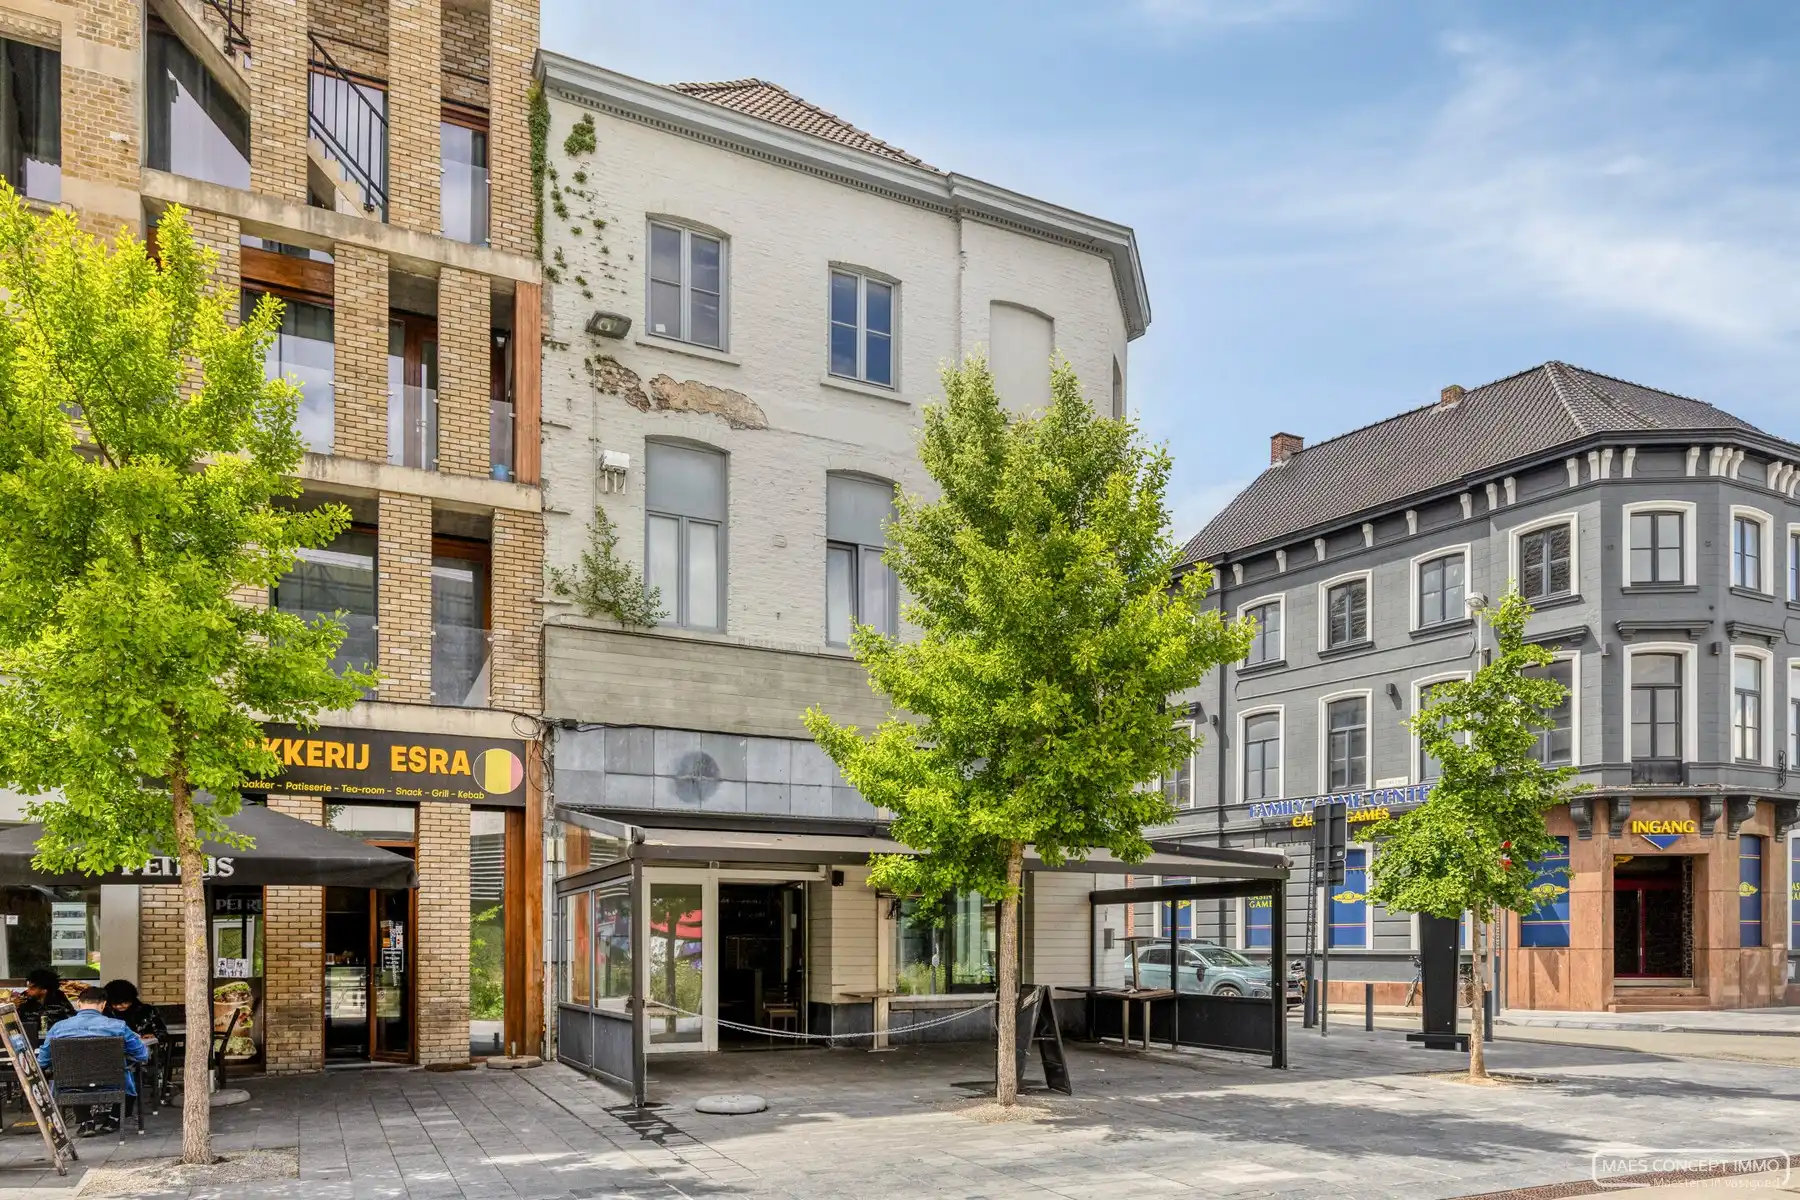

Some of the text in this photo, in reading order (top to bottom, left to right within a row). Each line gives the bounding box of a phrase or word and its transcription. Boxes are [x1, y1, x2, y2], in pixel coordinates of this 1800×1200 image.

[231, 737, 471, 776] KKERIJ ESRA
[286, 781, 332, 792] Patisserie
[341, 784, 385, 795] Tea-room
[395, 787, 423, 797] Snack
[431, 789, 449, 798] Grill
[457, 790, 485, 800] Kebab
[1249, 798, 1307, 819] FAMILY
[1369, 784, 1434, 806] CENTE
[1347, 807, 1390, 823] GAMES
[1631, 819, 1696, 835] INGANG
